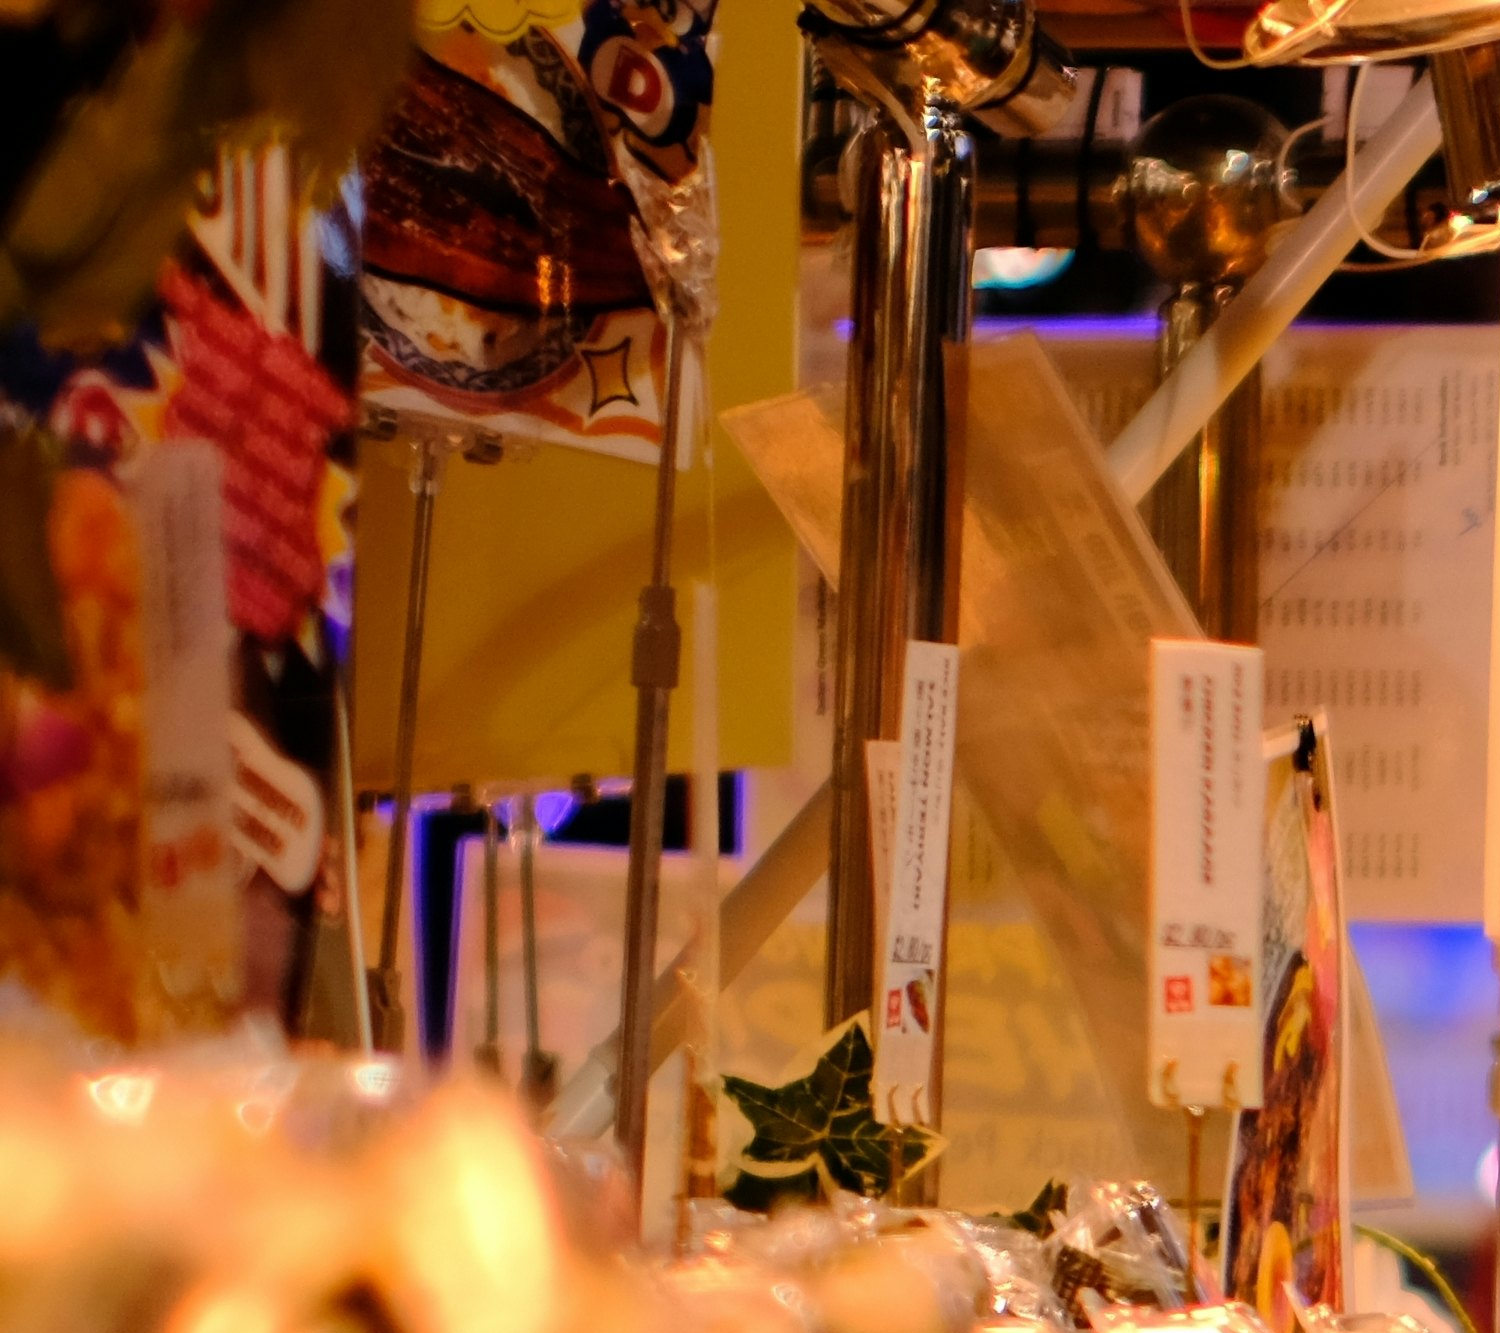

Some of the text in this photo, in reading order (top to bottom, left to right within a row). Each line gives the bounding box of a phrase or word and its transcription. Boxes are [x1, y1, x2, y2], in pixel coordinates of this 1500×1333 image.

[608, 45, 662, 113] D
[922, 681, 935, 788] SALMON
[913, 798, 928, 910] TERIYAKI
